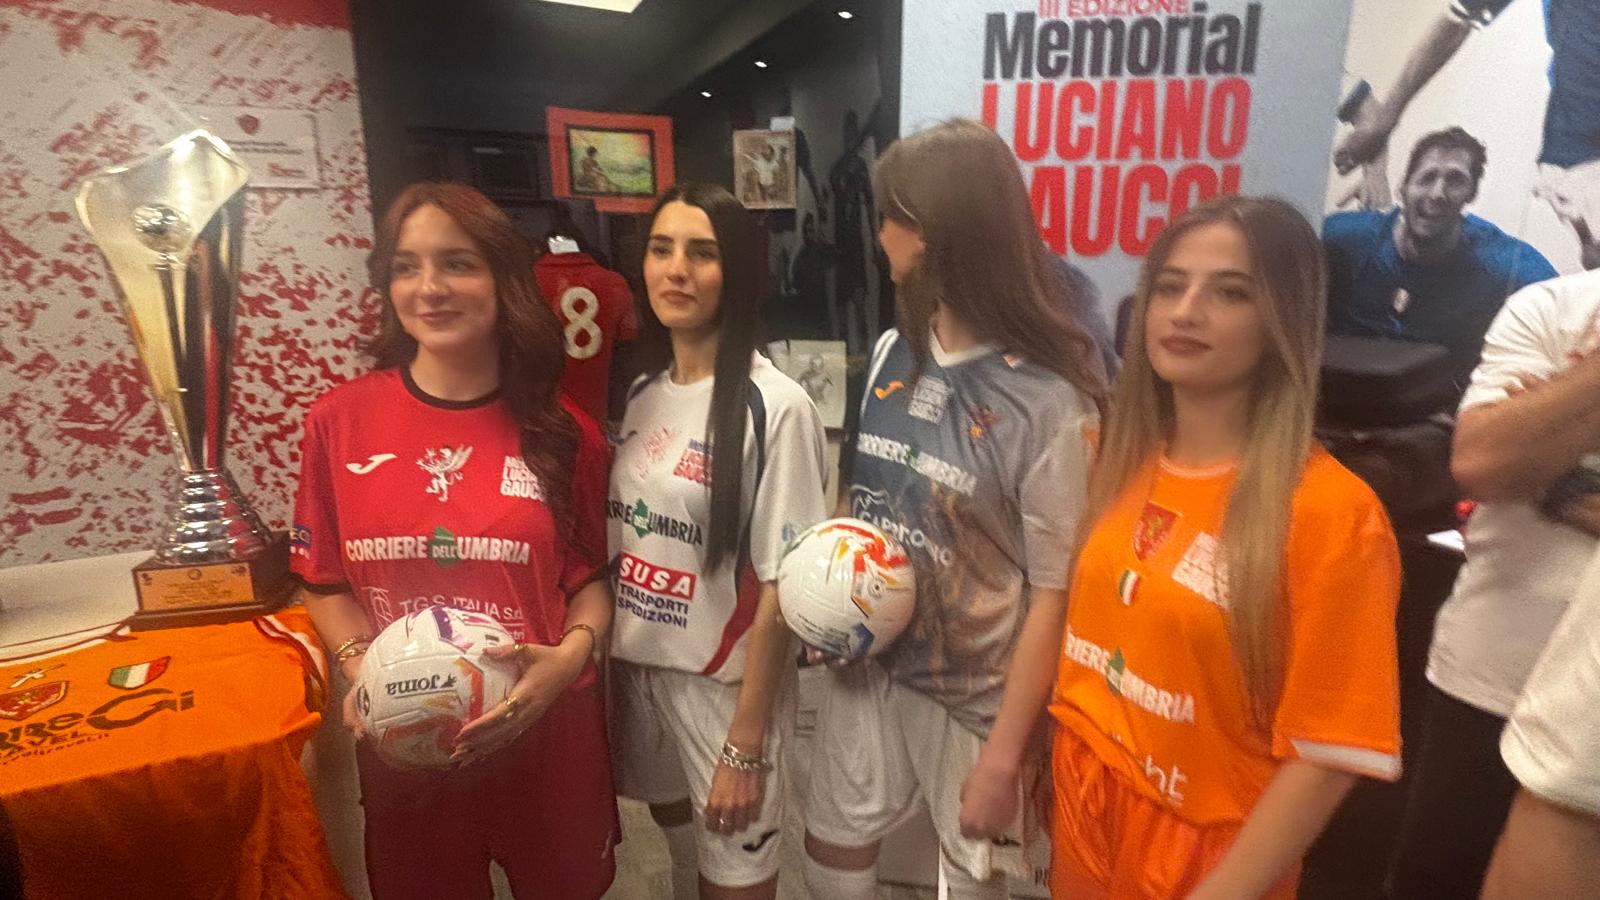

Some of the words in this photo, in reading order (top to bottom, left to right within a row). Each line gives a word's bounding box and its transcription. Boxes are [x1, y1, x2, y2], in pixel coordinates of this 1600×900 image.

[982, 2, 1263, 79] Memorial
[561, 286, 603, 359] 8
[647, 512, 702, 545] UMBRIA
[345, 536, 428, 561] CORRIERE
[457, 536, 530, 565] UMBRIA
[619, 557, 692, 598] SUSA
[617, 596, 687, 630] SPEDIZIONI
[620, 583, 688, 615] TRASPORTI
[385, 674, 440, 696] Joma
